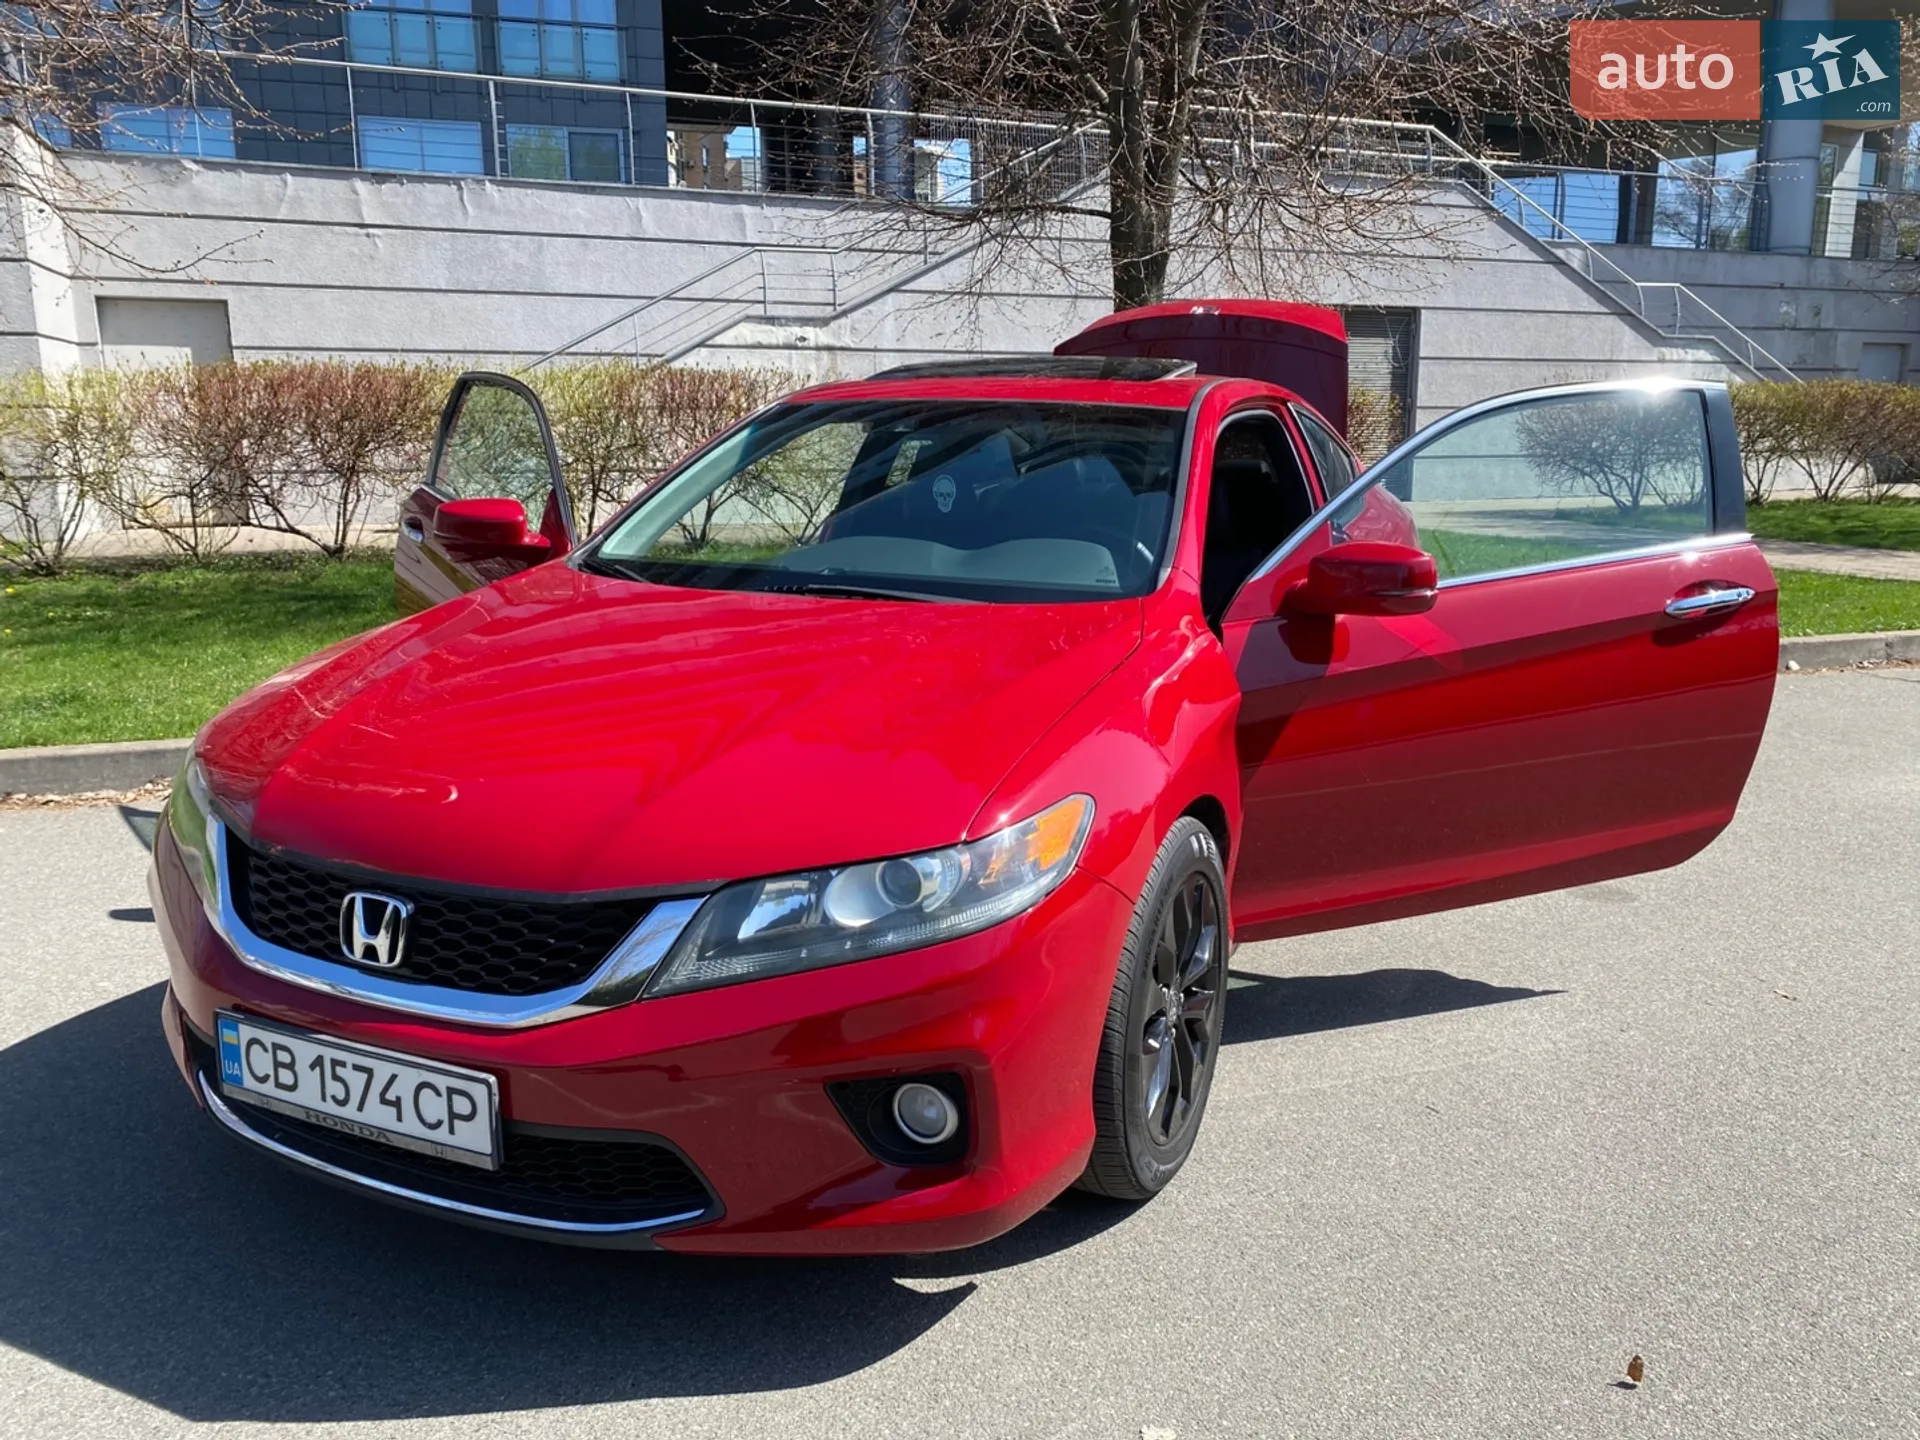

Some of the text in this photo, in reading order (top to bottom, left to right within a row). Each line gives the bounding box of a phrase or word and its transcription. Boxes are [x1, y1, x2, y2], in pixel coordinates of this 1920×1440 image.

[225, 1060, 241, 1077] UA
[245, 1037, 478, 1136] CB 1574 CP
[304, 1110, 394, 1144] HONDA
